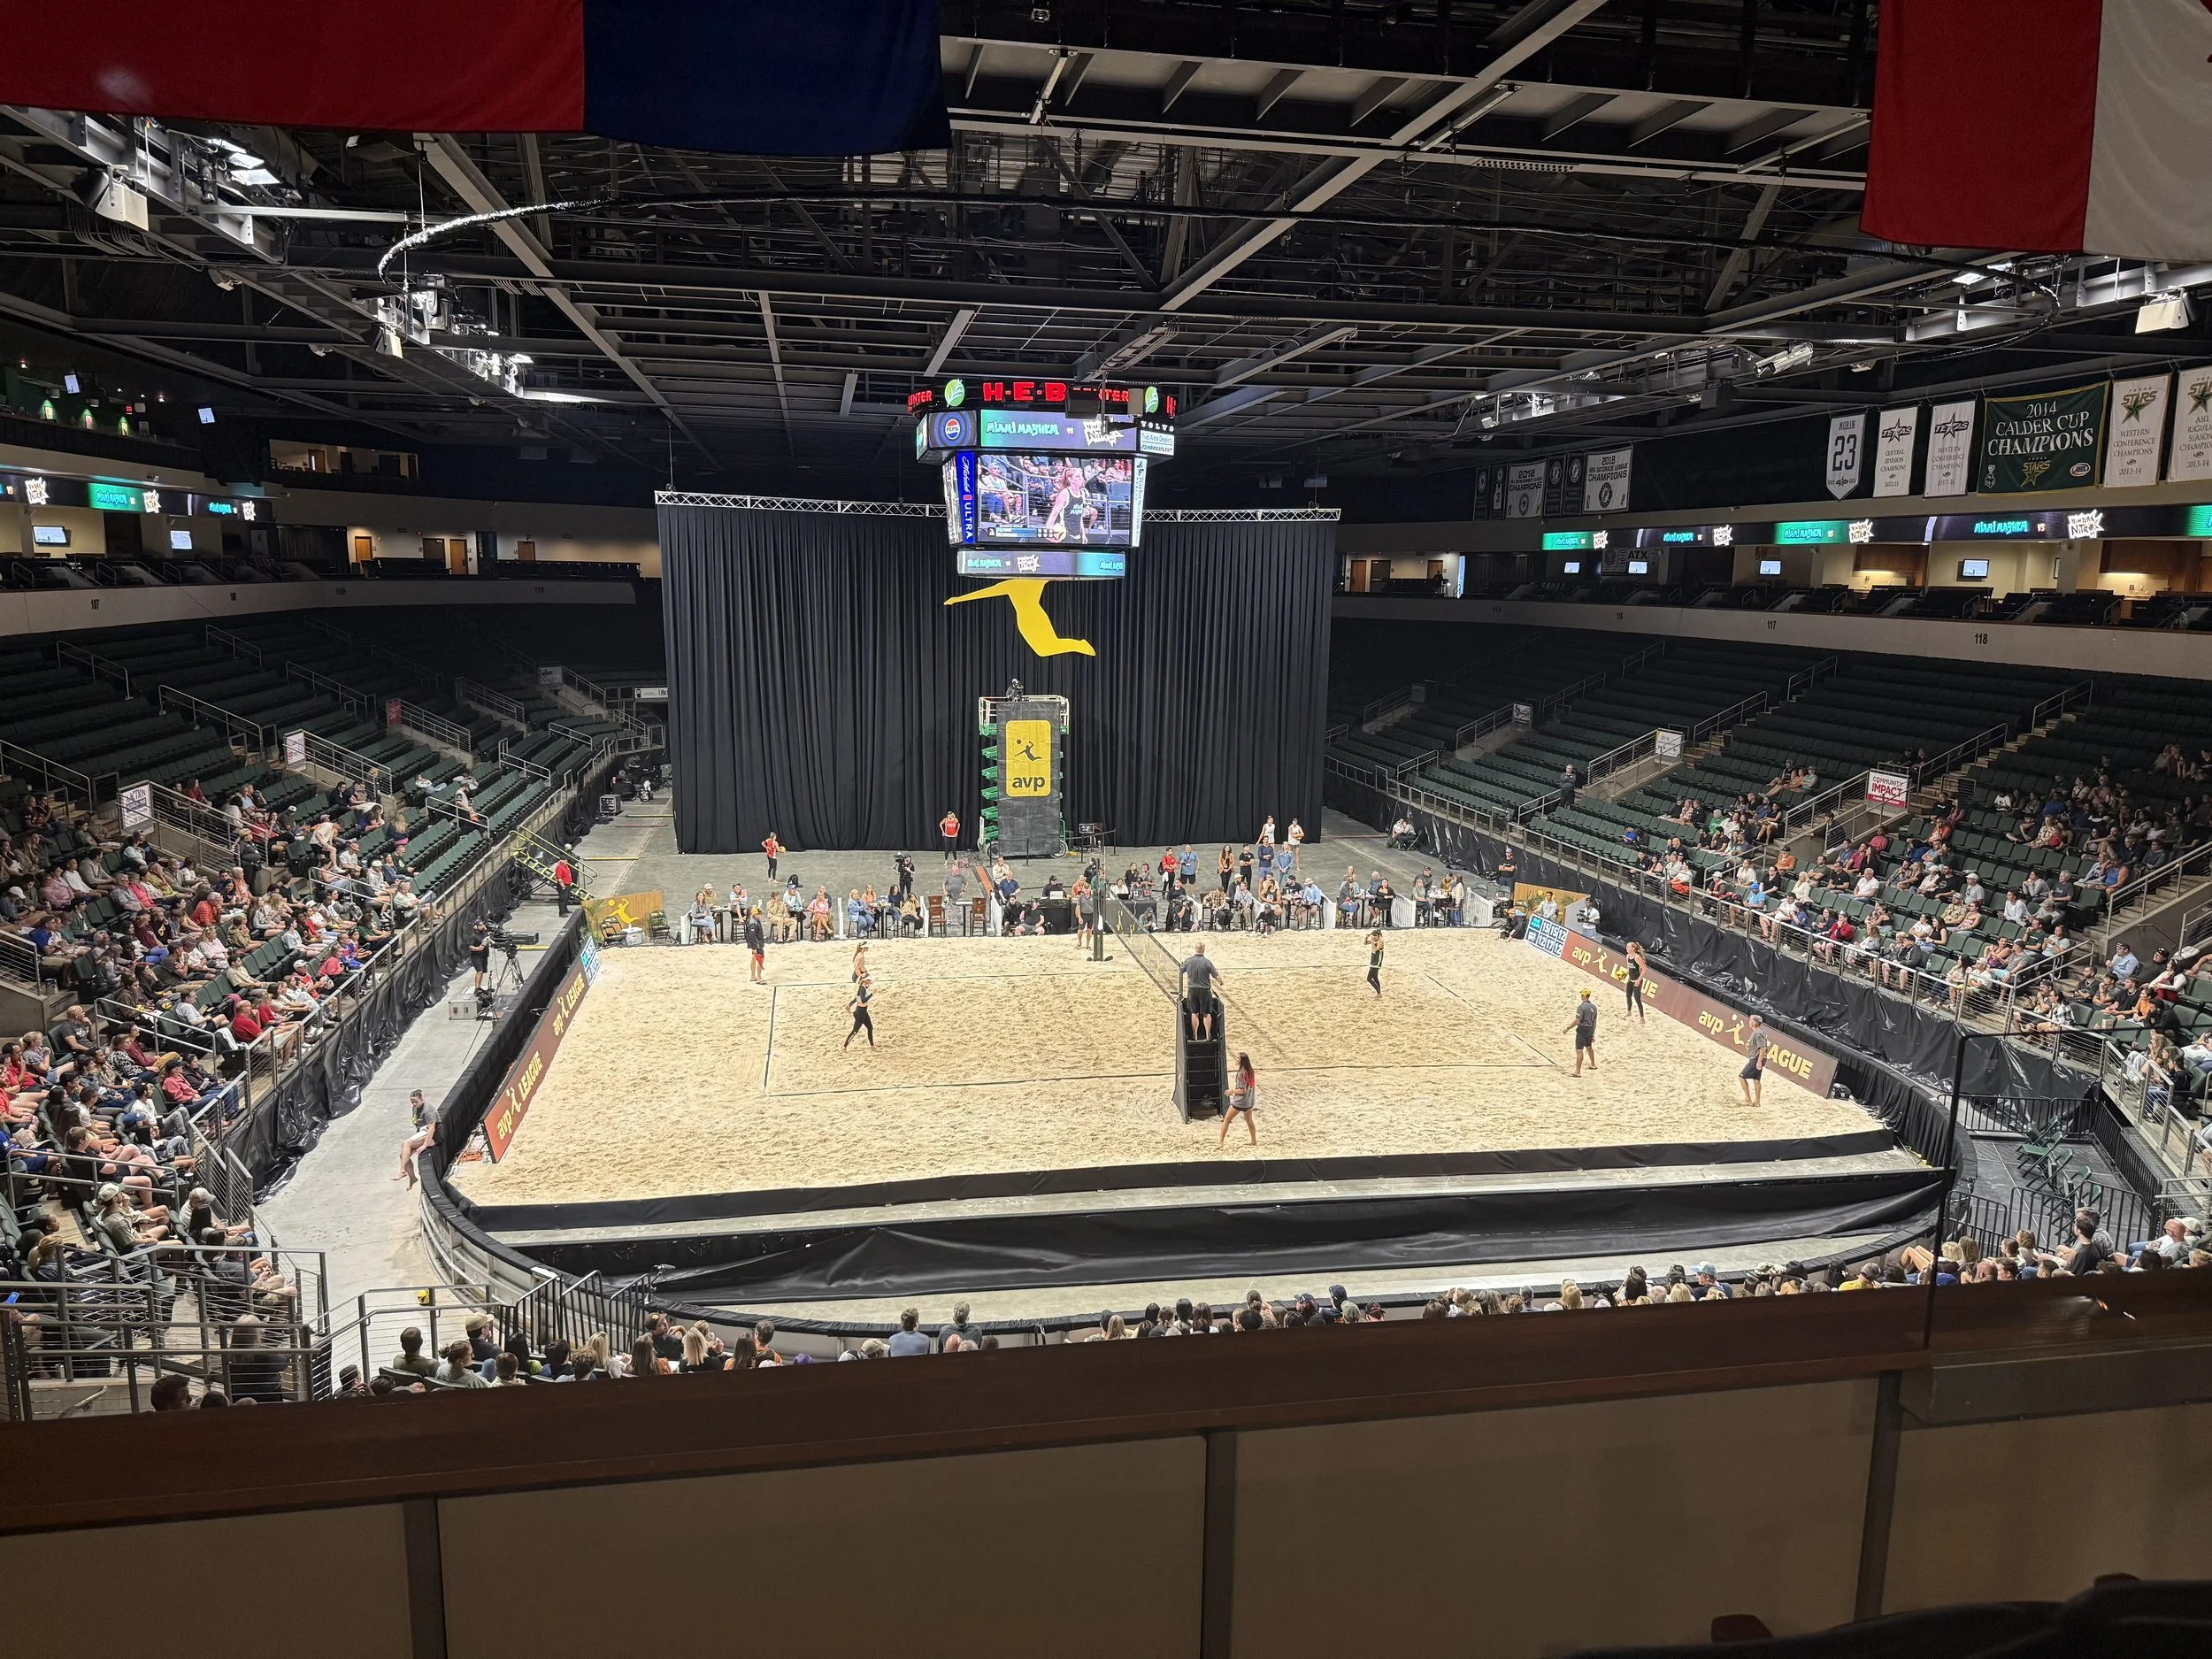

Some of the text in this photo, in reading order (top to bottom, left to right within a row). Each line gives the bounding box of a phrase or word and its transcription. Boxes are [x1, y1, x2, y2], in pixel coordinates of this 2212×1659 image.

[2121, 391, 2158, 405] STARS
[2026, 401, 2058, 418] 2014
[986, 421, 1059, 436] MIAMI MAYHEM
[1141, 421, 1174, 432] VOLVO
[1934, 421, 1969, 434] TEXAS
[1996, 411, 2089, 436] CALDER CUP
[1881, 426, 1912, 439] TEXAS
[2120, 428, 2150, 437] WESTERN
[1988, 428, 2094, 456] CHAMPIONS
[2113, 438, 2156, 447] CONFERENCE
[1832, 434, 1857, 472] 23
[1932, 454, 1965, 463] CONFERENCE
[2113, 448, 2153, 457] CHAMPIONS
[1601, 456, 1615, 465] 2018
[2022, 460, 2051, 471] STARS
[1518, 469, 1535, 479] 2012
[1588, 470, 1627, 482] CHAMPIONS
[1509, 481, 1542, 492] CHAMPIONS
[965, 503, 973, 539] ULTRA
[1974, 520, 2028, 534] MIAMI MAYHEM
[2037, 523, 2046, 532] VS
[1628, 550, 1648, 560] ATX
[90, 599, 100, 610] 107
[1767, 620, 1777, 630] 117
[1974, 633, 1988, 645] 118
[1012, 777, 1045, 791] avp
[1873, 776, 1903, 787] COMMUNITY
[1872, 783, 1903, 797] IMPACT
[1550, 924, 1558, 937] 15
[1572, 946, 1591, 966] avp
[553, 972, 584, 1037] avp LEAGUE
[1698, 1010, 1813, 1080] avp AGUE
[497, 1050, 543, 1141] avp LEAGUE
